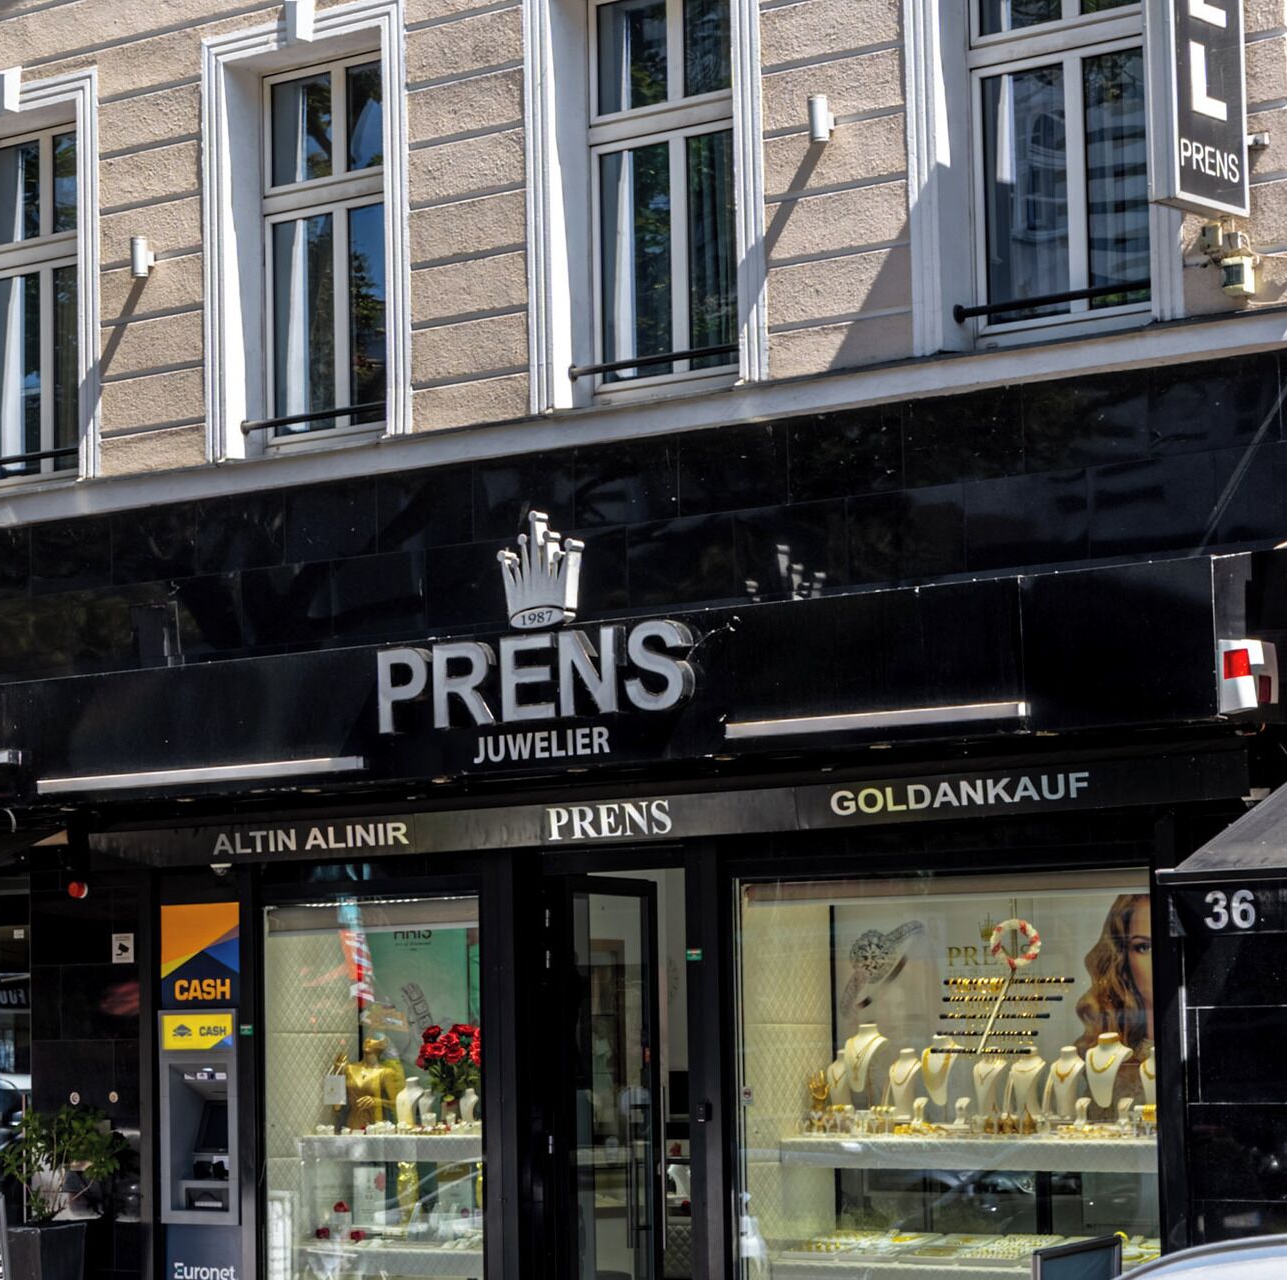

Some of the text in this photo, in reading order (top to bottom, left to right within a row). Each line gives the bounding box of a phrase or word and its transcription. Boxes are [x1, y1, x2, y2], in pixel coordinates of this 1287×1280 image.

[1180, 138, 1240, 183] PRENS
[520, 610, 554, 626] 1987
[377, 620, 692, 734] PRENS
[473, 726, 611, 764] JUWELIER
[831, 771, 1090, 816] GOLDANKAUF
[213, 822, 409, 855] ALTIN ALINIR
[546, 799, 673, 841] PRENS
[1204, 889, 1256, 930] 36
[174, 978, 231, 1001] CASH
[199, 1026, 226, 1037] CASH
